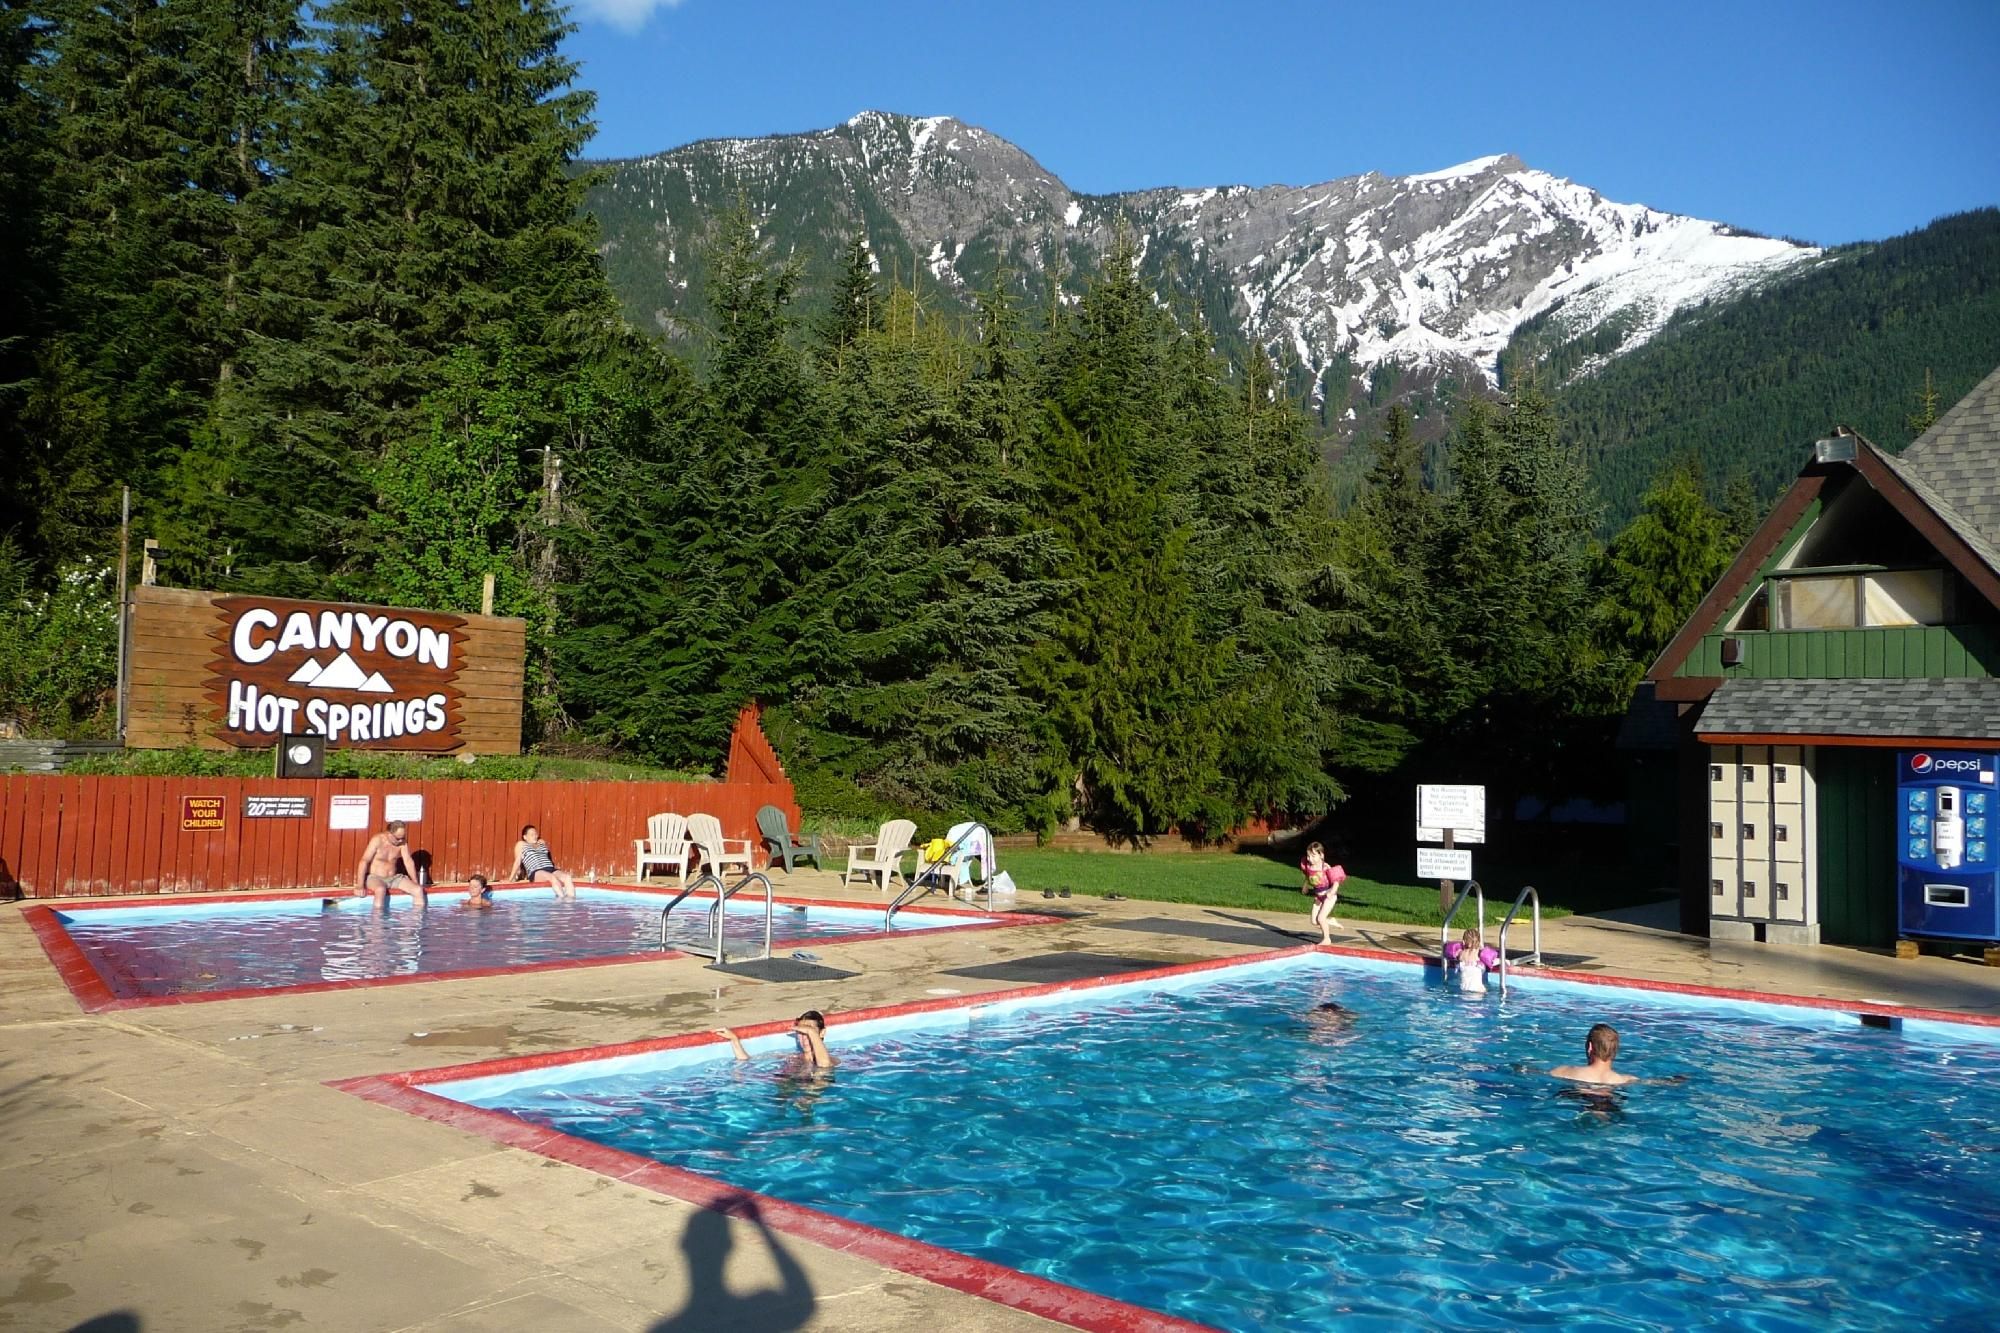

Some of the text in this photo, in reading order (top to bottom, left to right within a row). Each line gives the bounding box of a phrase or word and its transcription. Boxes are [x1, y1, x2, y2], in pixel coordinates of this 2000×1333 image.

[234, 608, 450, 670] CANYON
[228, 680, 447, 741] HOT SPRINGS
[1935, 758, 1981, 772] pepsi
[190, 799, 220, 808] WATCH
[248, 803, 266, 816] 20
[192, 809, 217, 818] YOUR
[184, 819, 224, 828] CHILDREN
